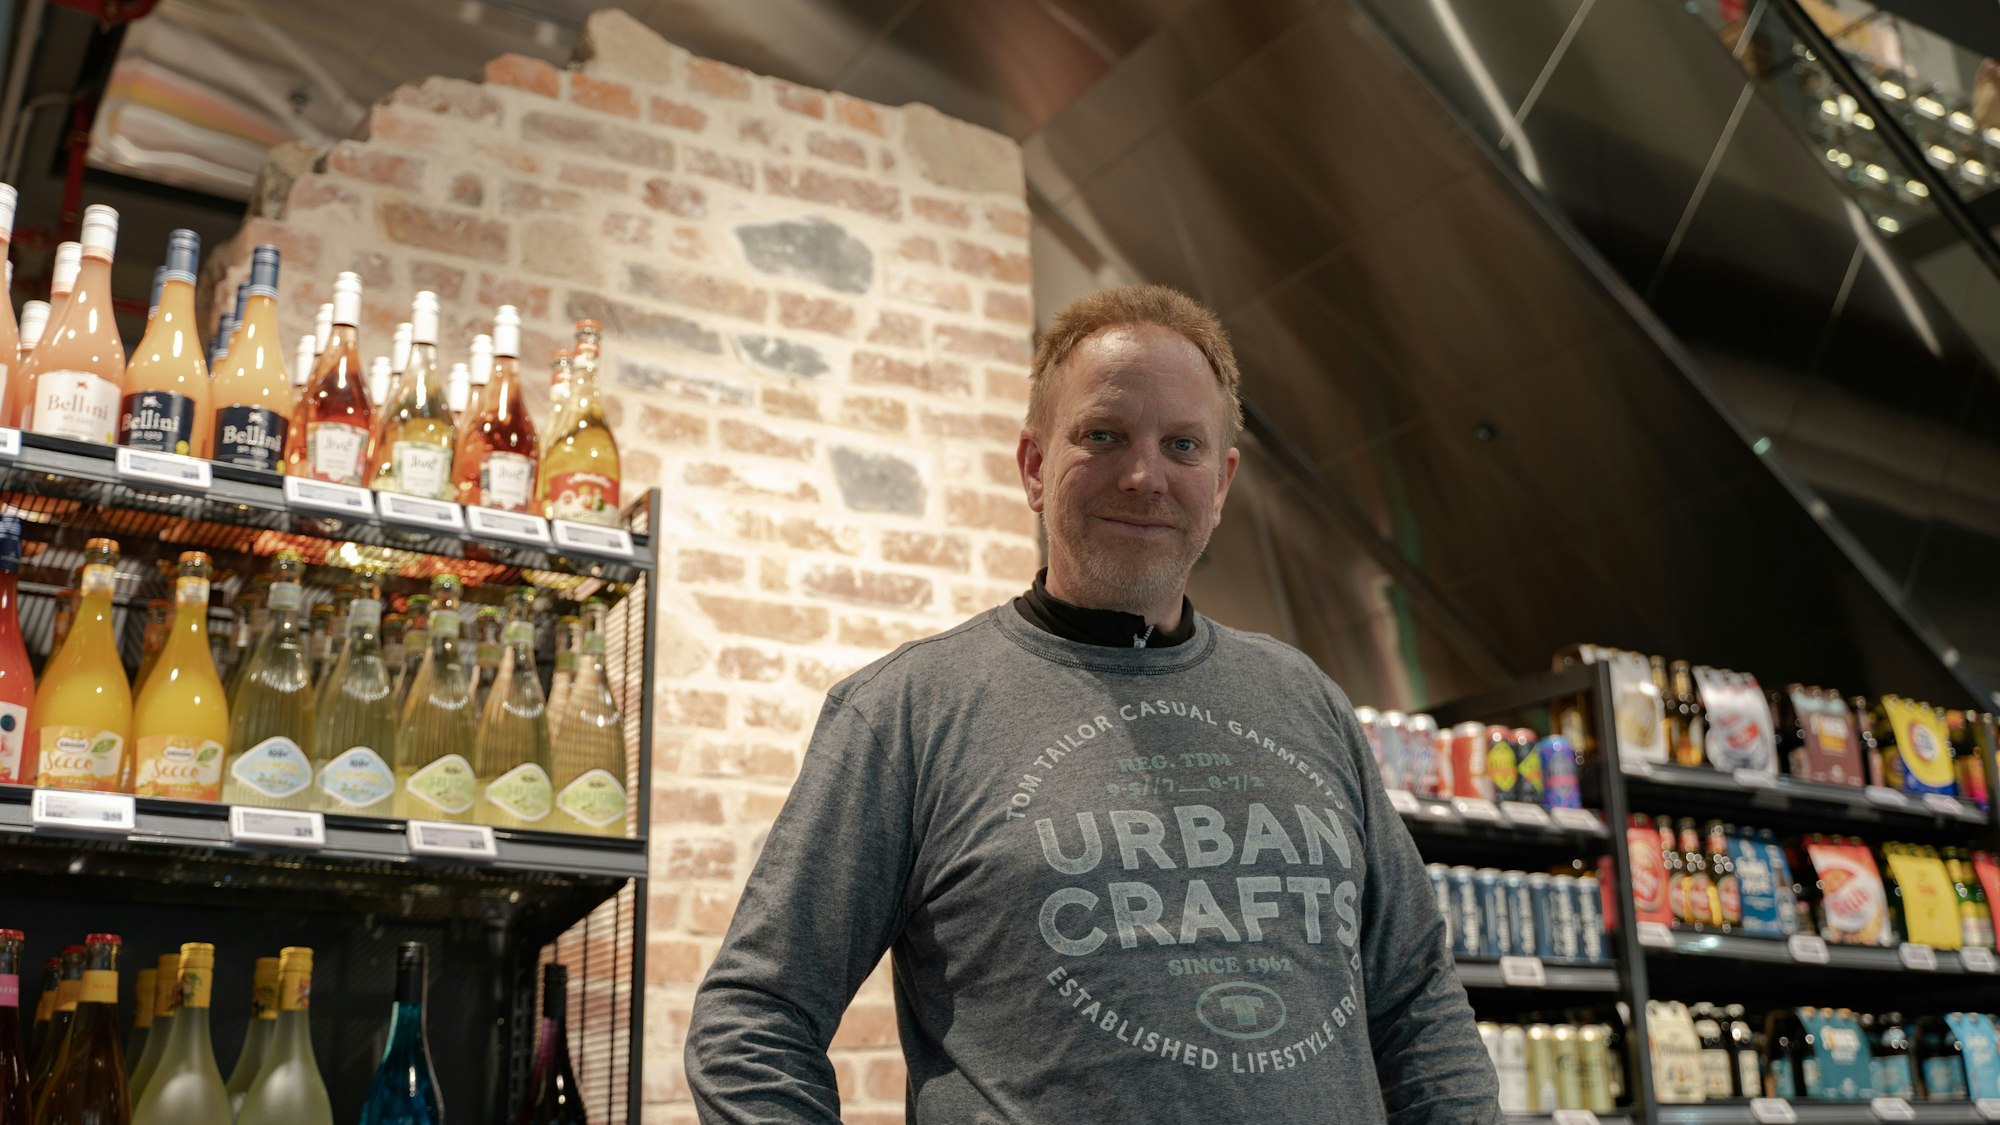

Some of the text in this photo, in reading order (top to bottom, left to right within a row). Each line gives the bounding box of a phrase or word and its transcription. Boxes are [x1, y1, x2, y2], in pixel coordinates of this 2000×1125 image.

[48, 394, 109, 420] Bellini
[121, 409, 180, 433] Bellini
[222, 424, 282, 453] Bellini
[45, 749, 93, 771] Secco
[1006, 773, 1042, 821] TOM
[1033, 714, 1113, 771] TAILOR
[1119, 700, 1217, 726] CASUAL
[1118, 752, 1232, 773] REG. TDM
[1035, 803, 1352, 875] URBAN
[1038, 875, 1358, 956] CRAFTS
[1168, 955, 1293, 976] SINCE 1962
[1046, 952, 1360, 1074] ESTABLISHED LIFESTYLE BRD
